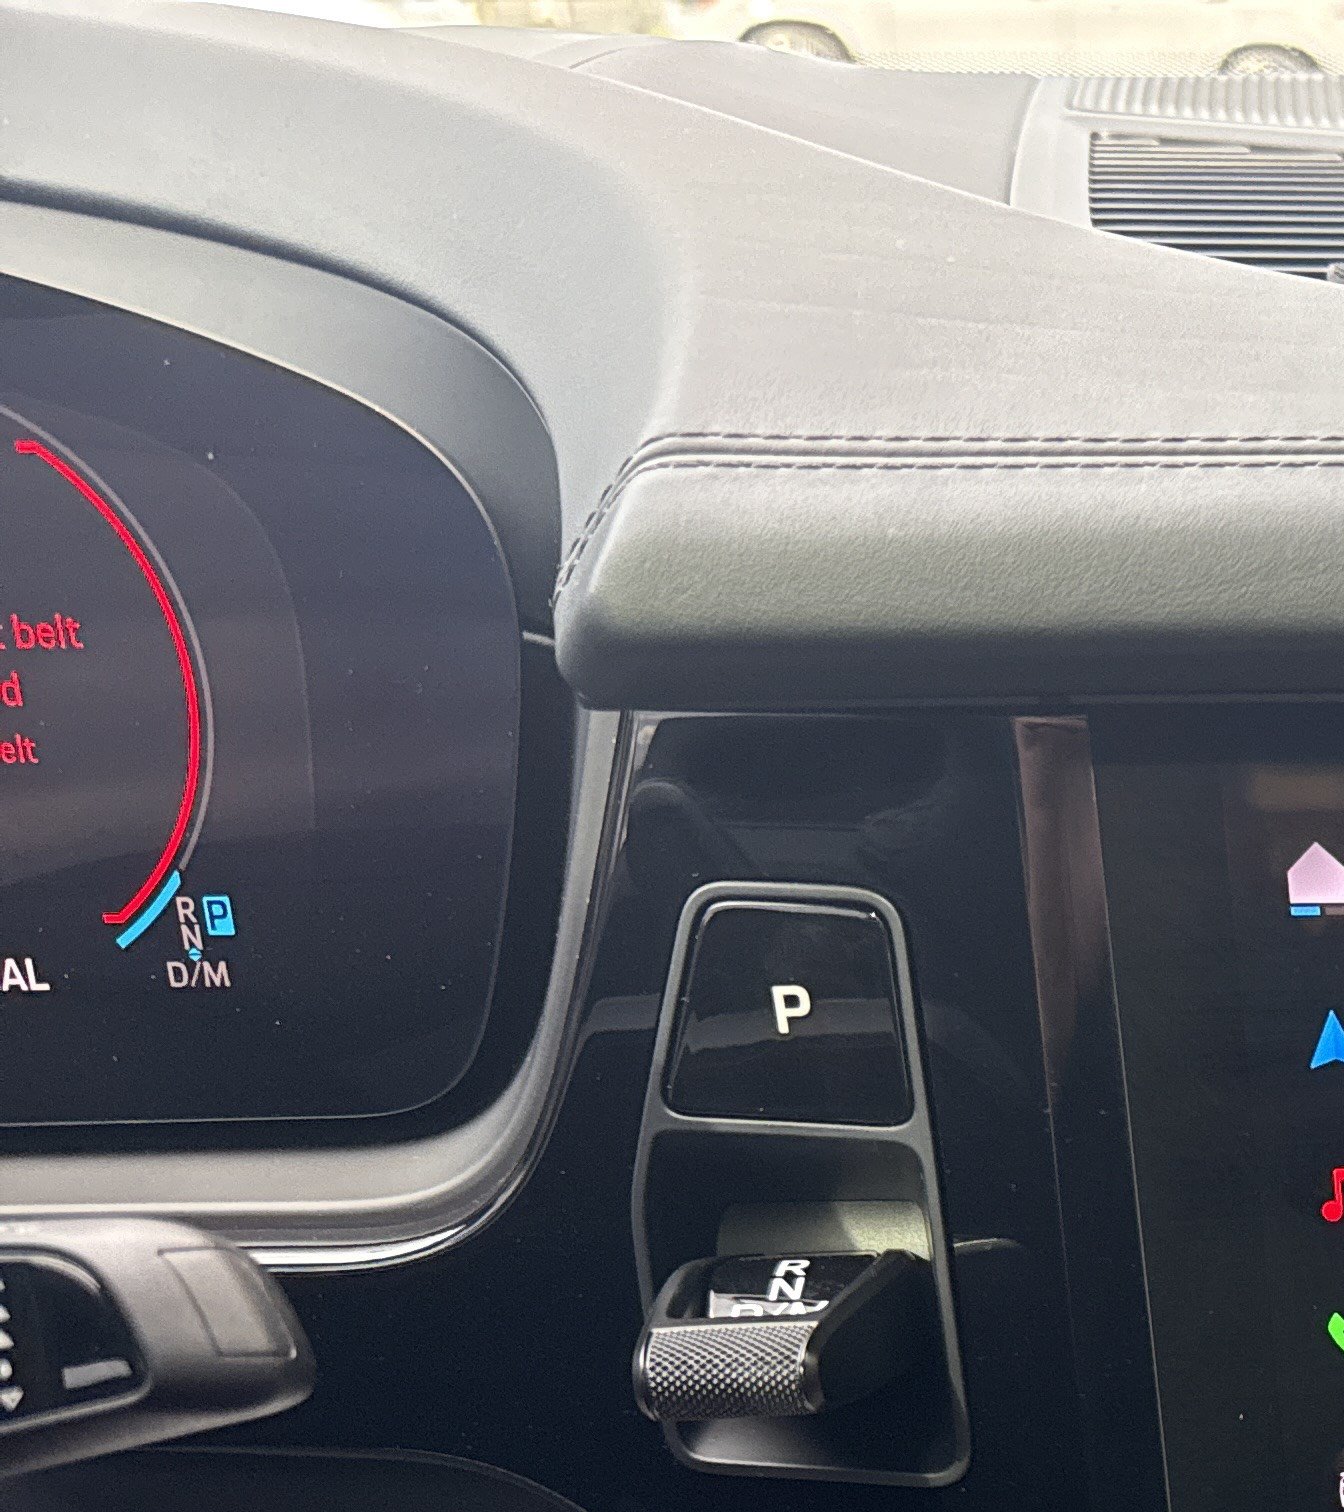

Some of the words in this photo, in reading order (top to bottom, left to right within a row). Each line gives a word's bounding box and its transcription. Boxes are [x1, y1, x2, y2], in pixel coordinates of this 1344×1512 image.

[10, 613, 84, 649] belt
[175, 896, 198, 923] R
[207, 900, 228, 930] P
[181, 924, 204, 951] N
[166, 961, 231, 988] D/M
[772, 984, 811, 1034] P
[775, 1259, 811, 1277] R
[768, 1276, 806, 1301] N
